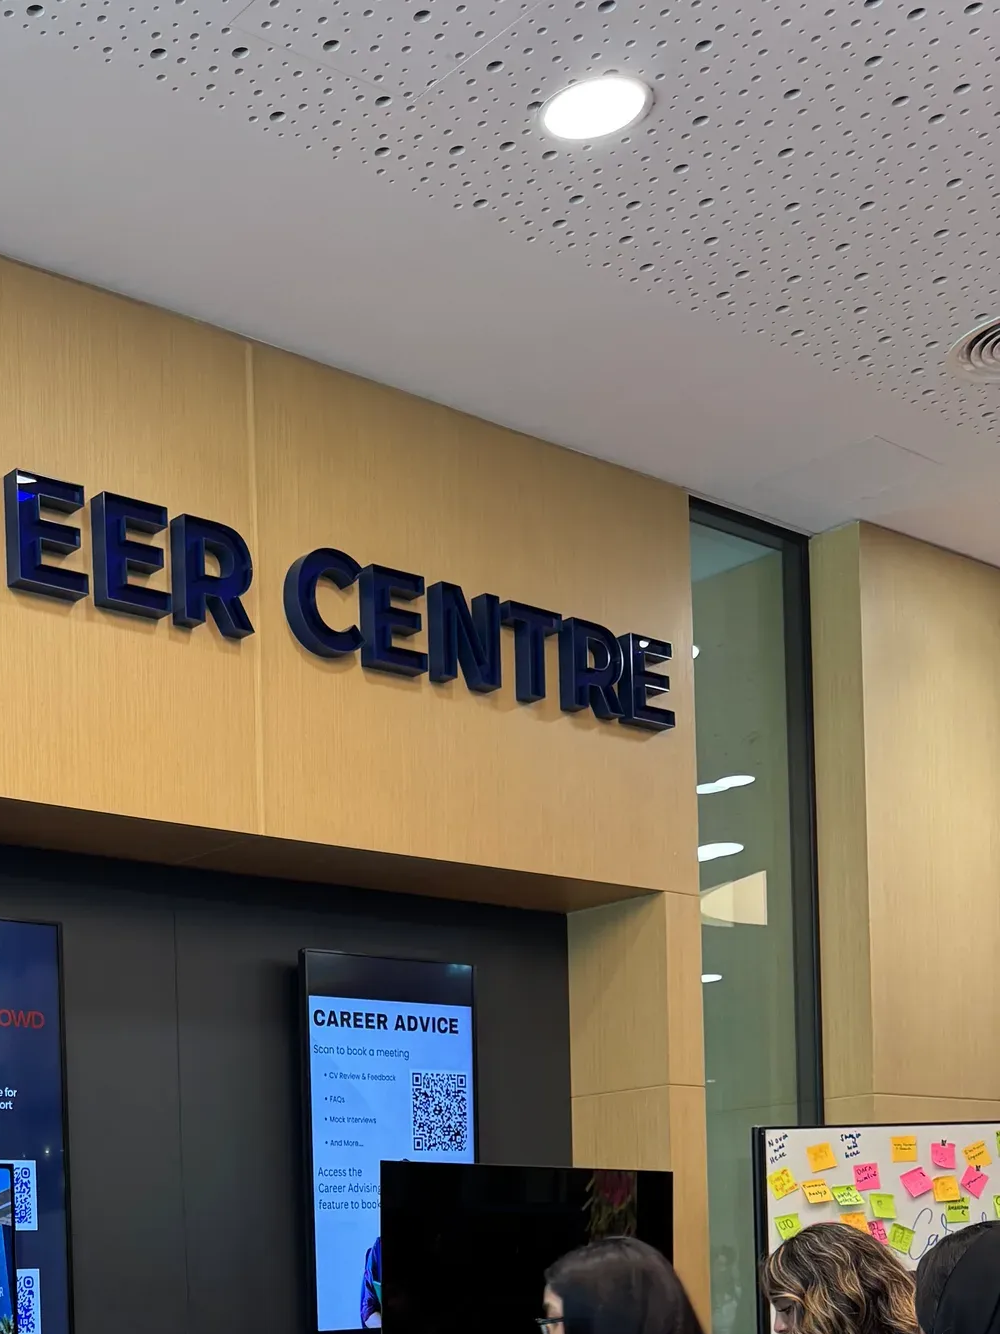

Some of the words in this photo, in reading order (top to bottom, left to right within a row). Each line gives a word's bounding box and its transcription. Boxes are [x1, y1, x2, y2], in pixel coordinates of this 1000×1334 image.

[284, 547, 676, 732] CENTRE
[313, 1009, 389, 1031] CAREER
[394, 1014, 459, 1035] ADVICE
[313, 1044, 335, 1055] Scan
[336, 1045, 346, 1055] to
[347, 1046, 367, 1057] book
[376, 1049, 410, 1061] meeting
[329, 1071, 338, 1080] CV
[339, 1072, 361, 1080] Review
[361, 1072, 367, 1080] &
[367, 1073, 396, 1082] Feedback
[4, 1087, 18, 1099] for
[329, 1095, 346, 1104] FAQs
[329, 1116, 346, 1124] Mock
[346, 1116, 377, 1124] Interviews
[318, 1167, 347, 1177] Access
[348, 1167, 363, 1177] the
[318, 1182, 346, 1194] Career
[318, 1199, 349, 1210] feature
[350, 1199, 360, 1210] to
